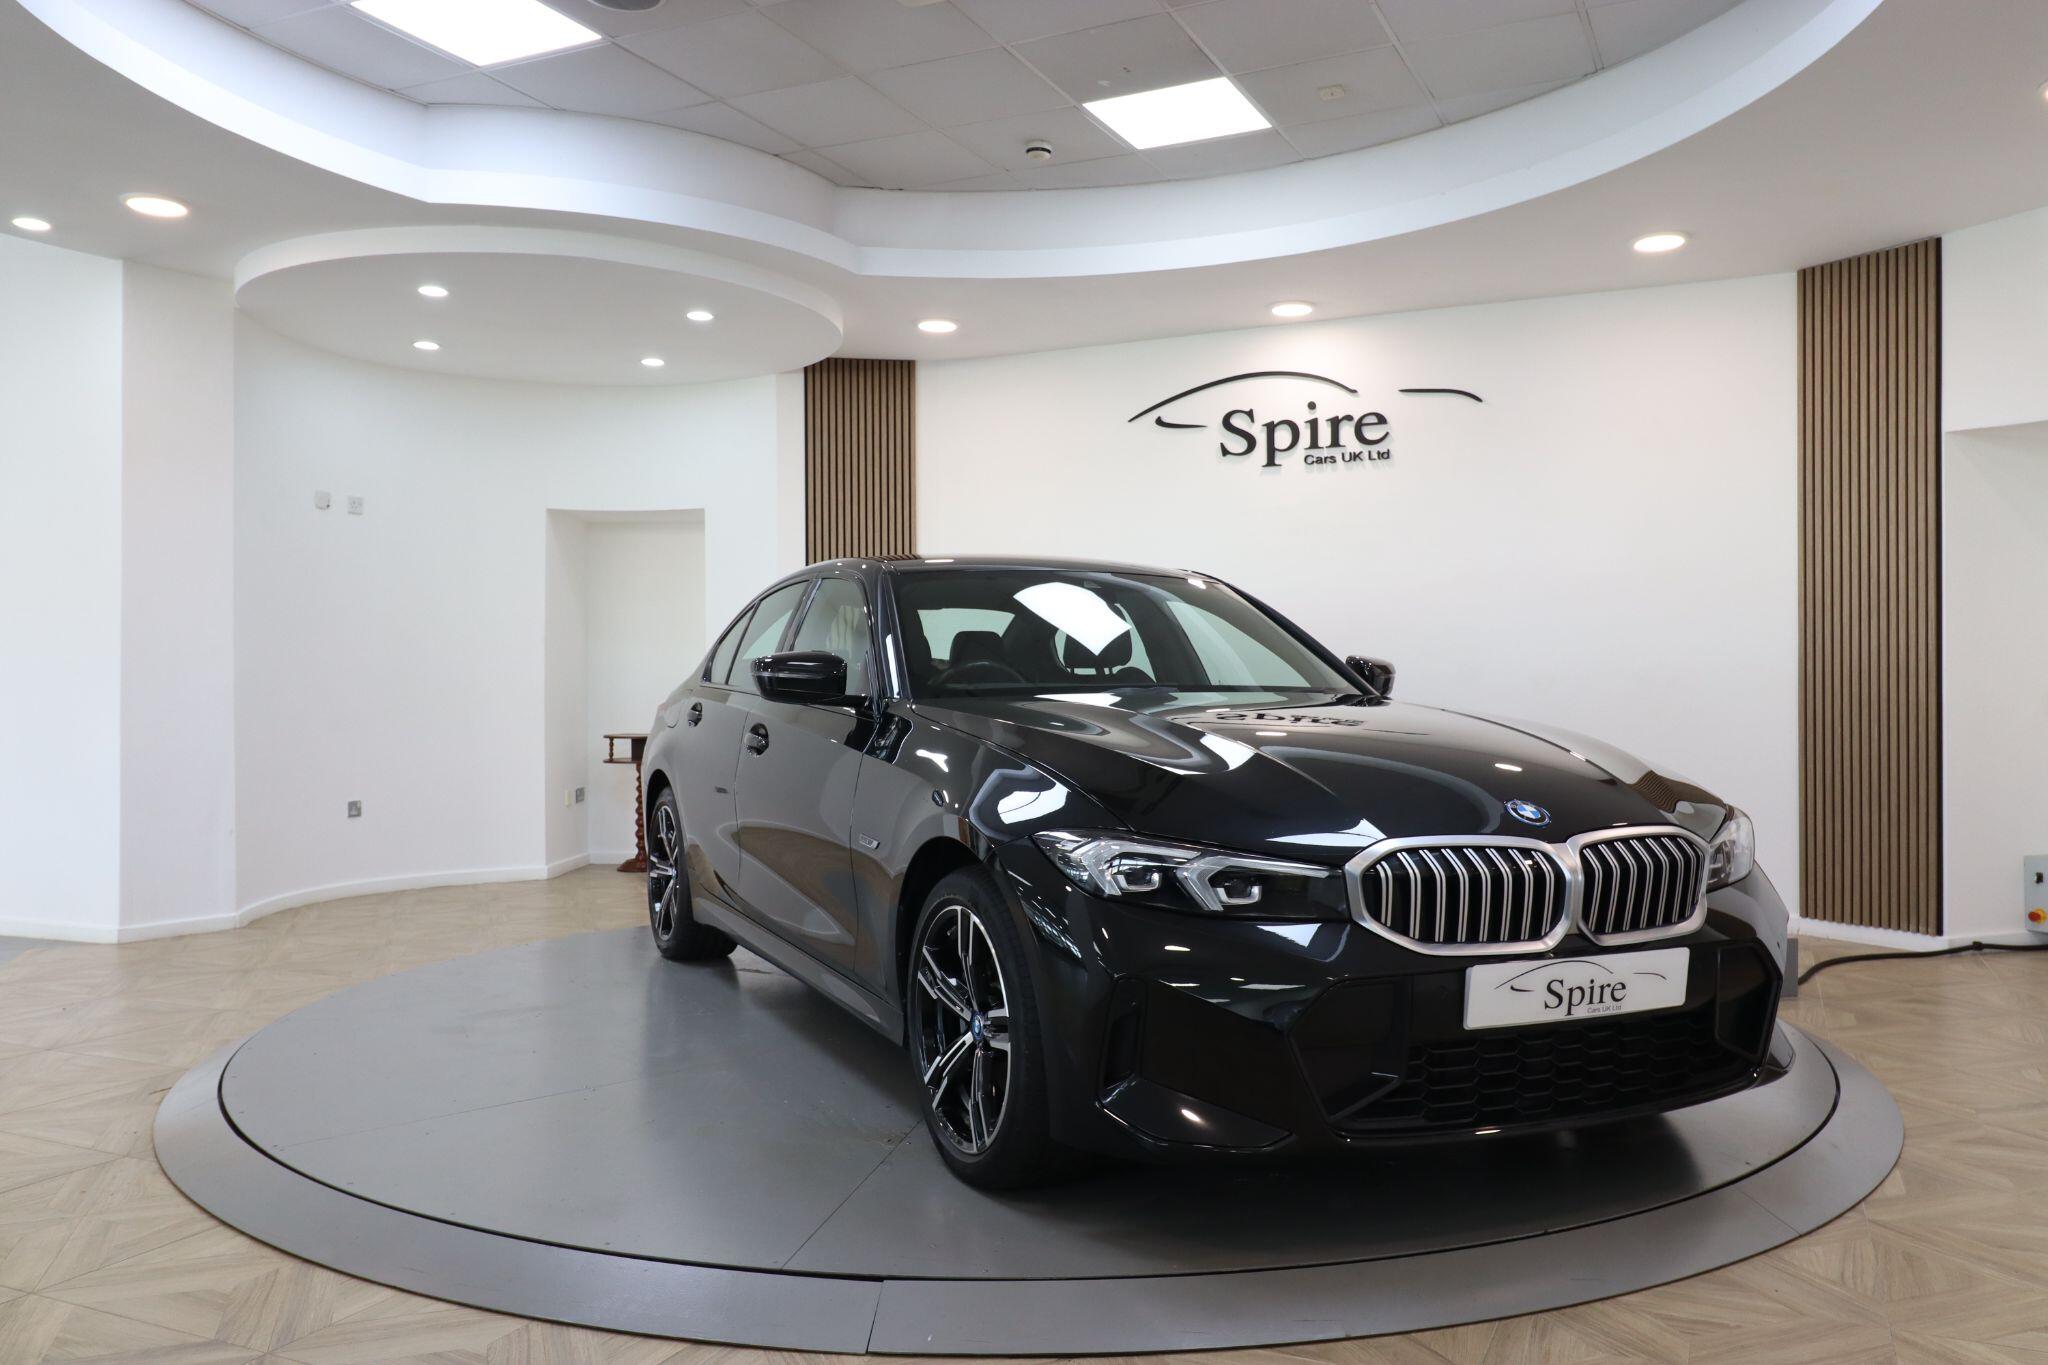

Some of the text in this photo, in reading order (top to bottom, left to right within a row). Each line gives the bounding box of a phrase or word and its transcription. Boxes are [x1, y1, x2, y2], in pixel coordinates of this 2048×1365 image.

[1219, 401, 1390, 468] Spire
[1303, 448, 1391, 465] Cars UK Ltd
[1544, 978, 1627, 1017] Spire
